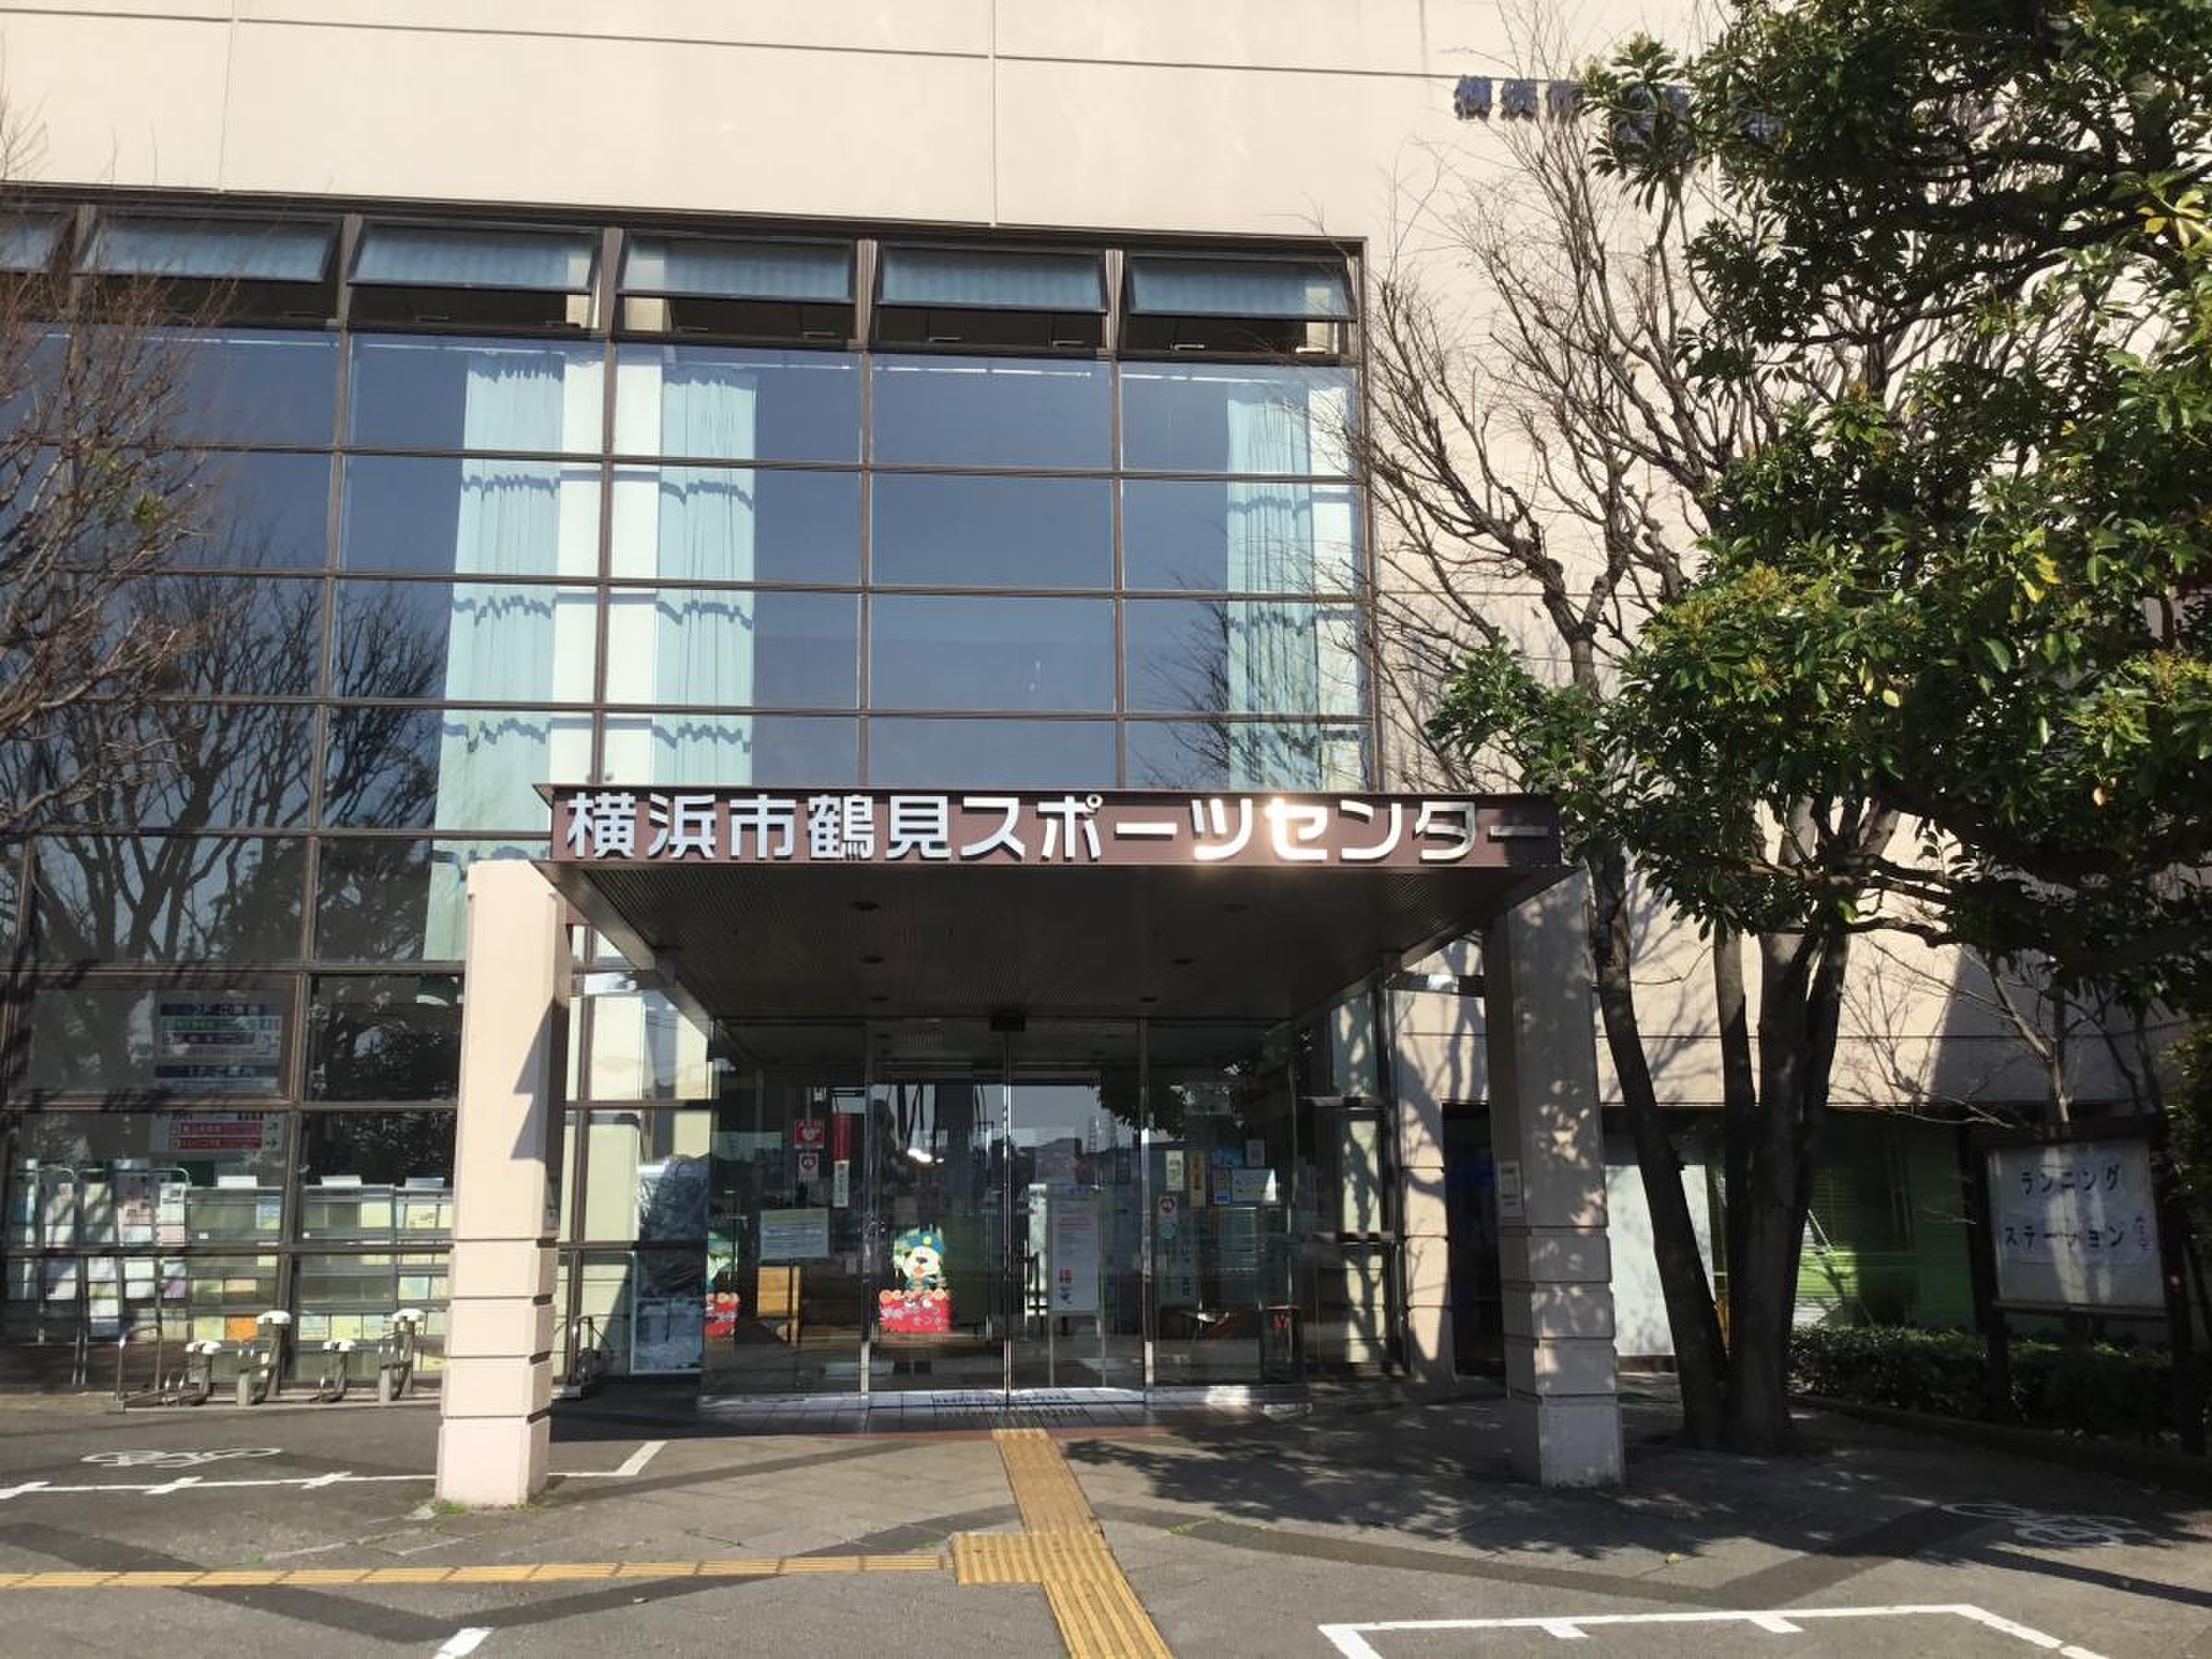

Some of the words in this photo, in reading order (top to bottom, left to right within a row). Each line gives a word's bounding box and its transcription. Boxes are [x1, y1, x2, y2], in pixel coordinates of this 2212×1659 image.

[567, 793, 1548, 861] 横浜市鶴見スポーツセンター
[2020, 1165, 2120, 1195] ランニング
